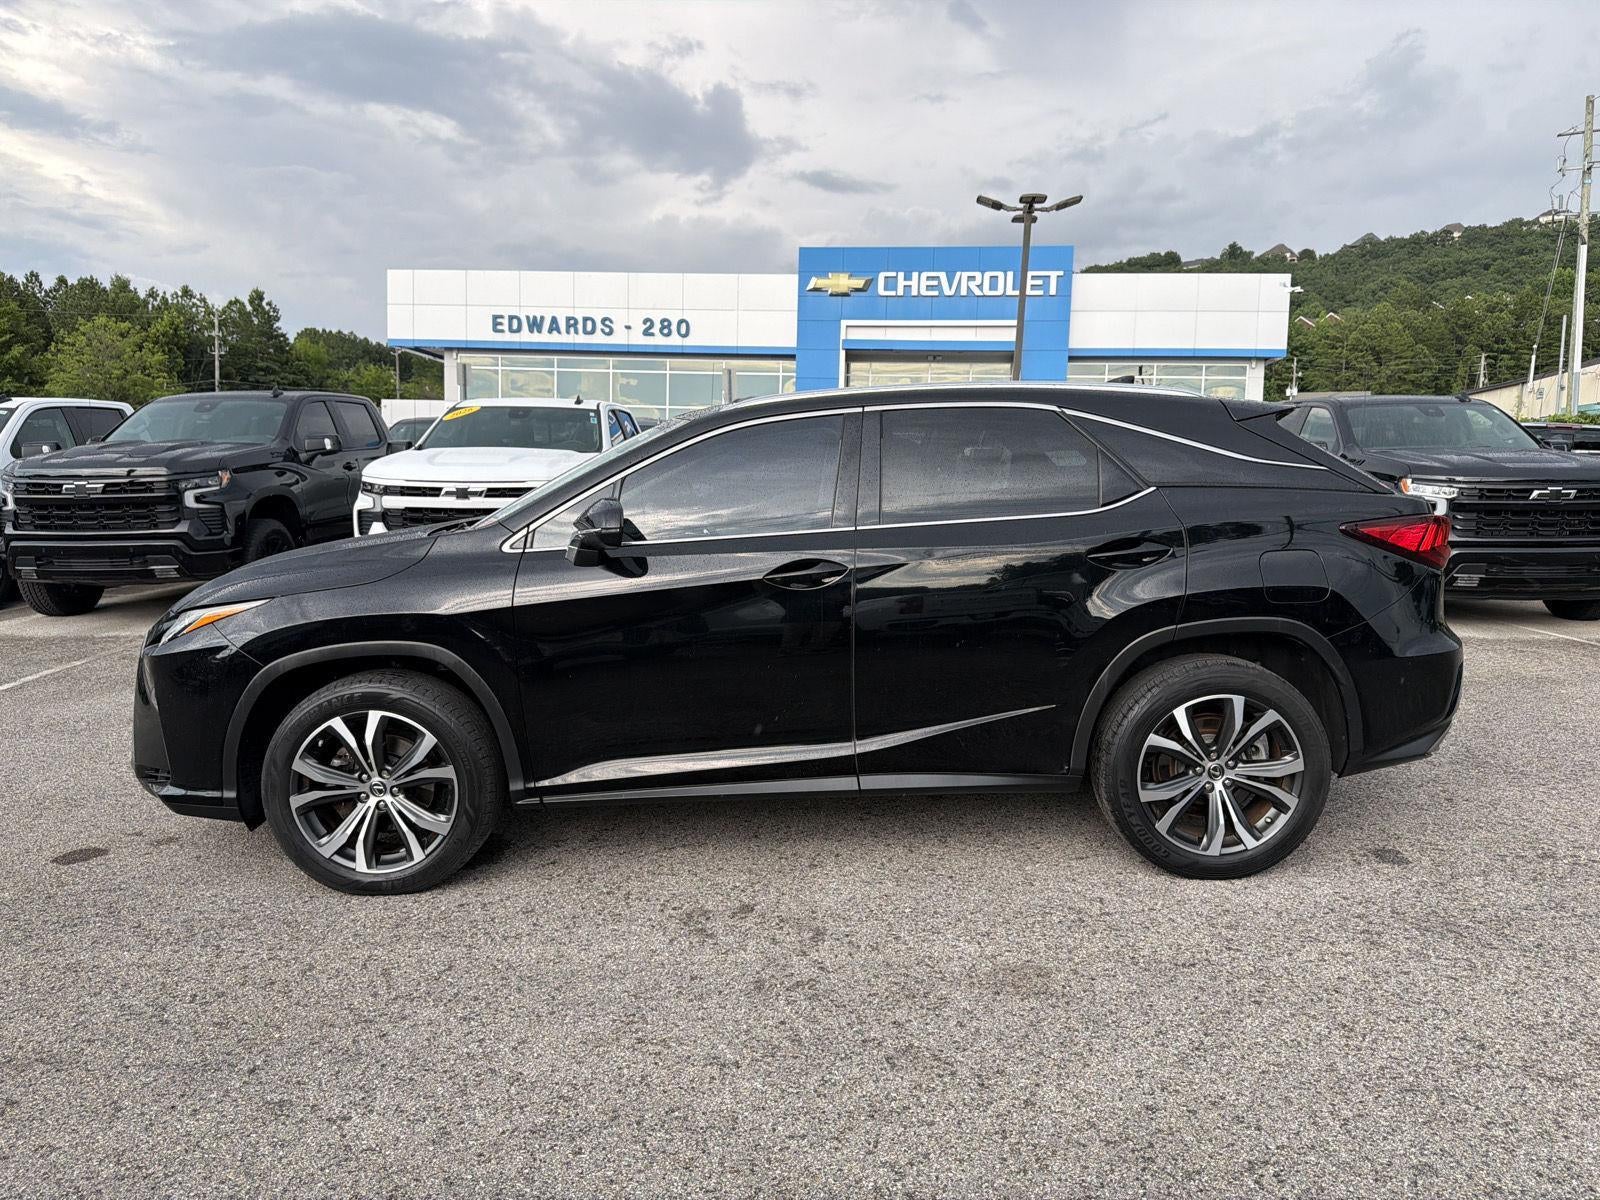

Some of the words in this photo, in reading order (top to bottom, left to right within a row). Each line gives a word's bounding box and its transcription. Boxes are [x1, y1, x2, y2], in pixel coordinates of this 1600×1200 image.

[877, 271, 1064, 296] CHEVROLET
[492, 314, 614, 336] EDWARDS
[642, 317, 691, 339] 280
[1119, 780, 1169, 858] GOODYEAR
